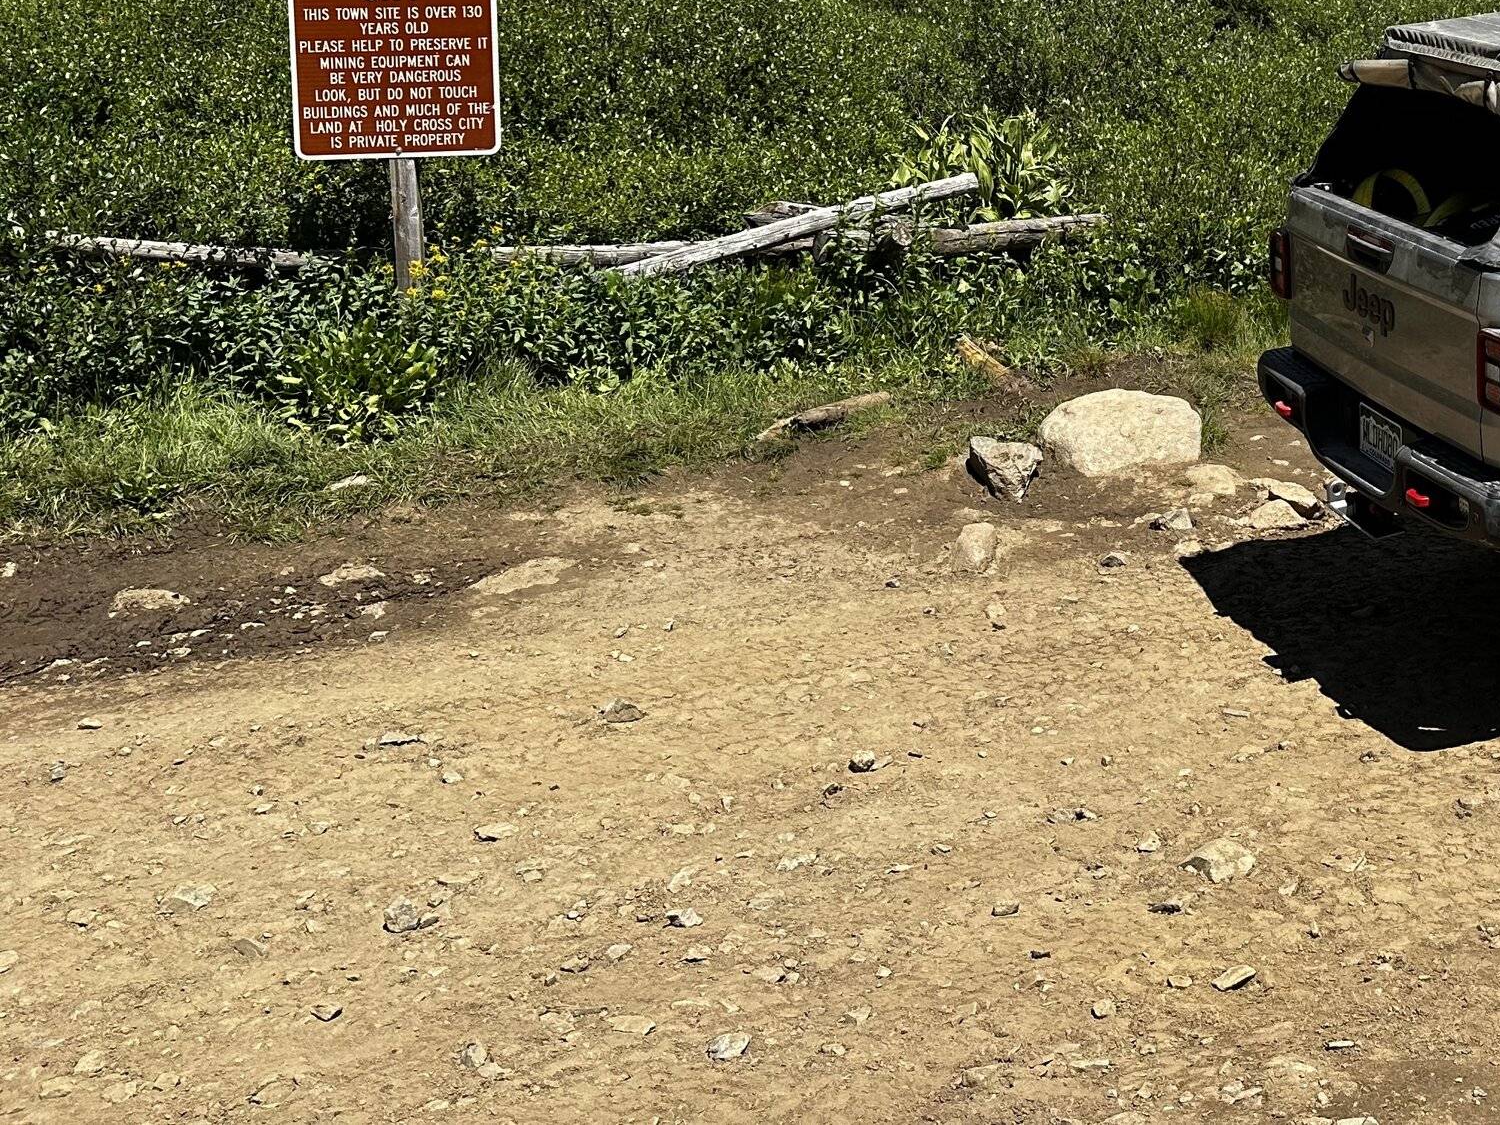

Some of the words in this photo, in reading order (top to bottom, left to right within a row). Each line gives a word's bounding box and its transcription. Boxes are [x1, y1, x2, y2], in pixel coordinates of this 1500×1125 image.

[304, 8, 329, 20] THIS
[336, 7, 368, 20] TOWN
[375, 7, 400, 19] SITE
[408, 7, 418, 19] IS
[426, 6, 456, 18] OVER
[462, 5, 482, 17] 130
[360, 22, 399, 35] YEARS
[405, 22, 428, 34] OLD
[300, 40, 345, 53] PLEASE
[352, 40, 383, 51] HELP
[389, 39, 403, 51] TO
[410, 38, 471, 51] PRESERVE
[478, 37, 488, 49] IT
[320, 57, 364, 69] MINING
[371, 55, 440, 68] EQUIPMENT
[446, 54, 470, 66] CAN
[330, 72, 346, 84] BE
[352, 71, 382, 83] VERY
[390, 69, 461, 83] DANGEROUS
[316, 89, 351, 103] LOOK,
[358, 88, 380, 101] BUT
[388, 88, 403, 100] DO
[410, 87, 432, 99] NOT
[438, 86, 477, 98] TOUCH
[304, 105, 368, 119] BUILDINGS
[374, 105, 399, 117] AND
[406, 104, 440, 116] MUCH
[447, 103, 462, 115] OF
[468, 103, 490, 114] THE
[310, 121, 342, 134] LAND
[349, 121, 362, 133] AT
[376, 119, 407, 132] HOLY
[414, 118, 452, 131] CROSS
[459, 117, 484, 129] CITY
[331, 136, 342, 148] IS
[349, 135, 398, 148] PRIVATE
[405, 133, 465, 146] PROPERTY
[1343, 274, 1395, 337] Jeep
